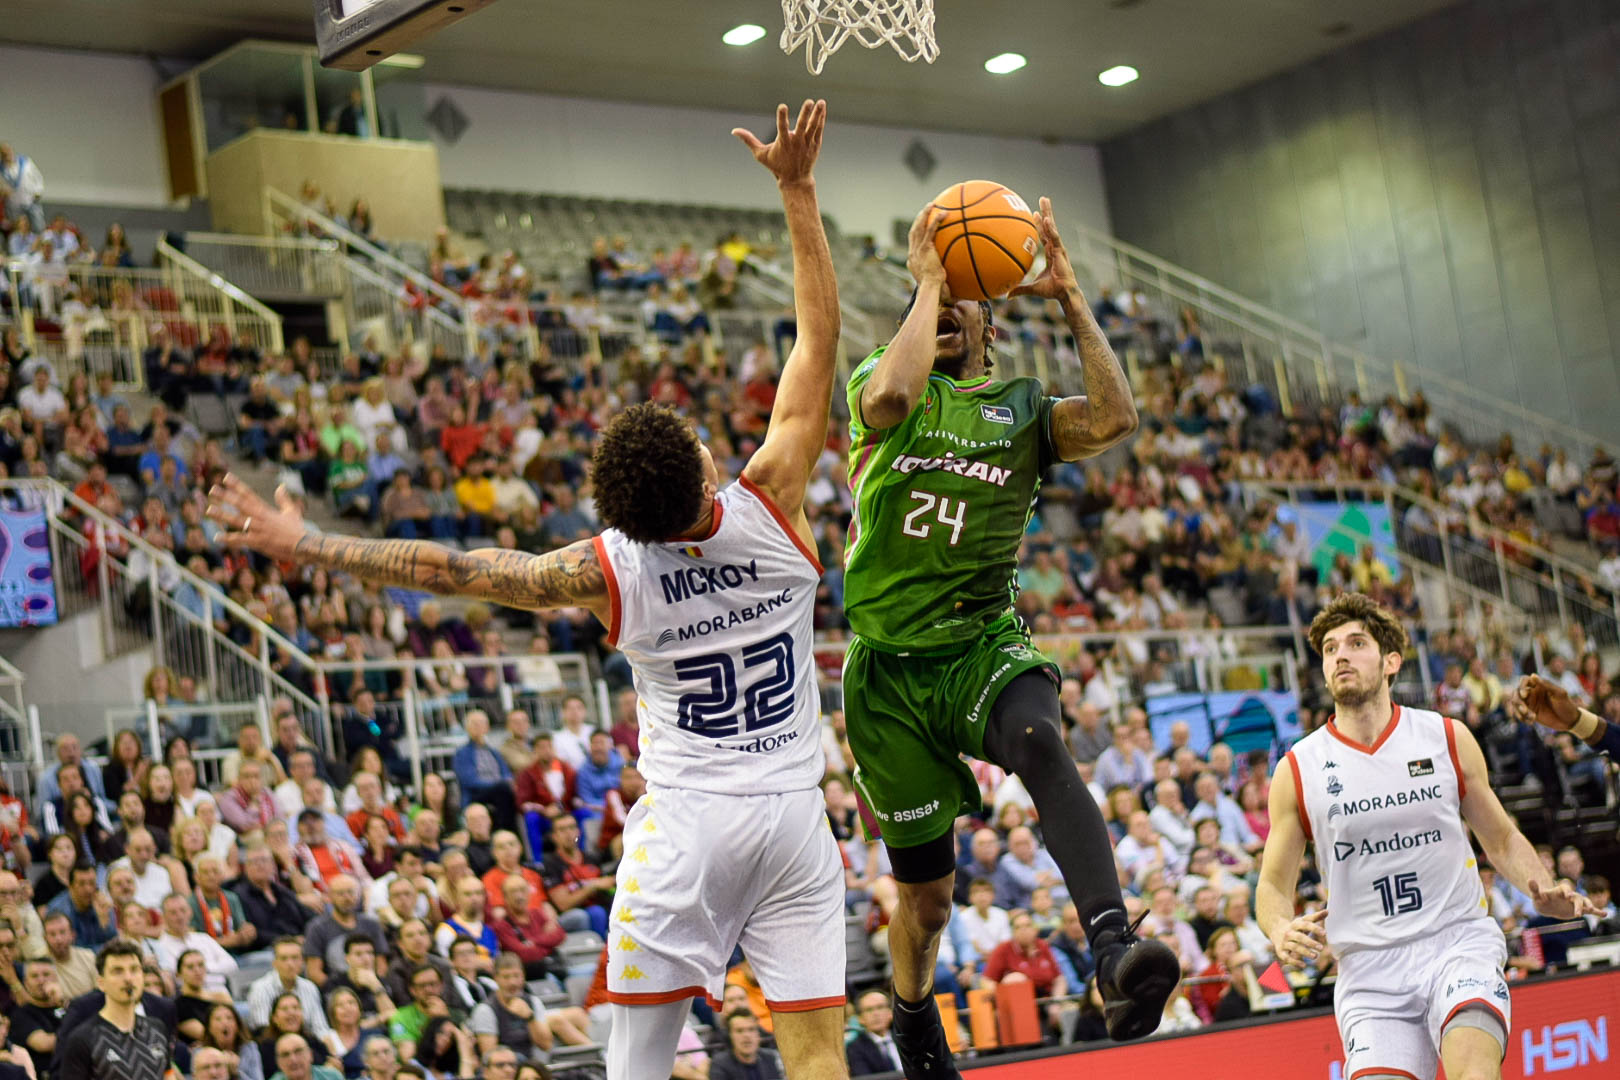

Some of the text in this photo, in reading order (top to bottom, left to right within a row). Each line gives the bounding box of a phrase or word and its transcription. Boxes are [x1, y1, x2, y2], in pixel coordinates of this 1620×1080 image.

[903, 490, 966, 545] 24
[660, 559, 759, 605] MCKOY
[678, 588, 793, 641] MORABANC
[674, 632, 795, 738] 22
[1343, 785, 1442, 816] MORABANC
[1359, 829, 1442, 856] Andorra
[1372, 872, 1423, 916] 15
[1522, 1015, 1608, 1077] HSN
